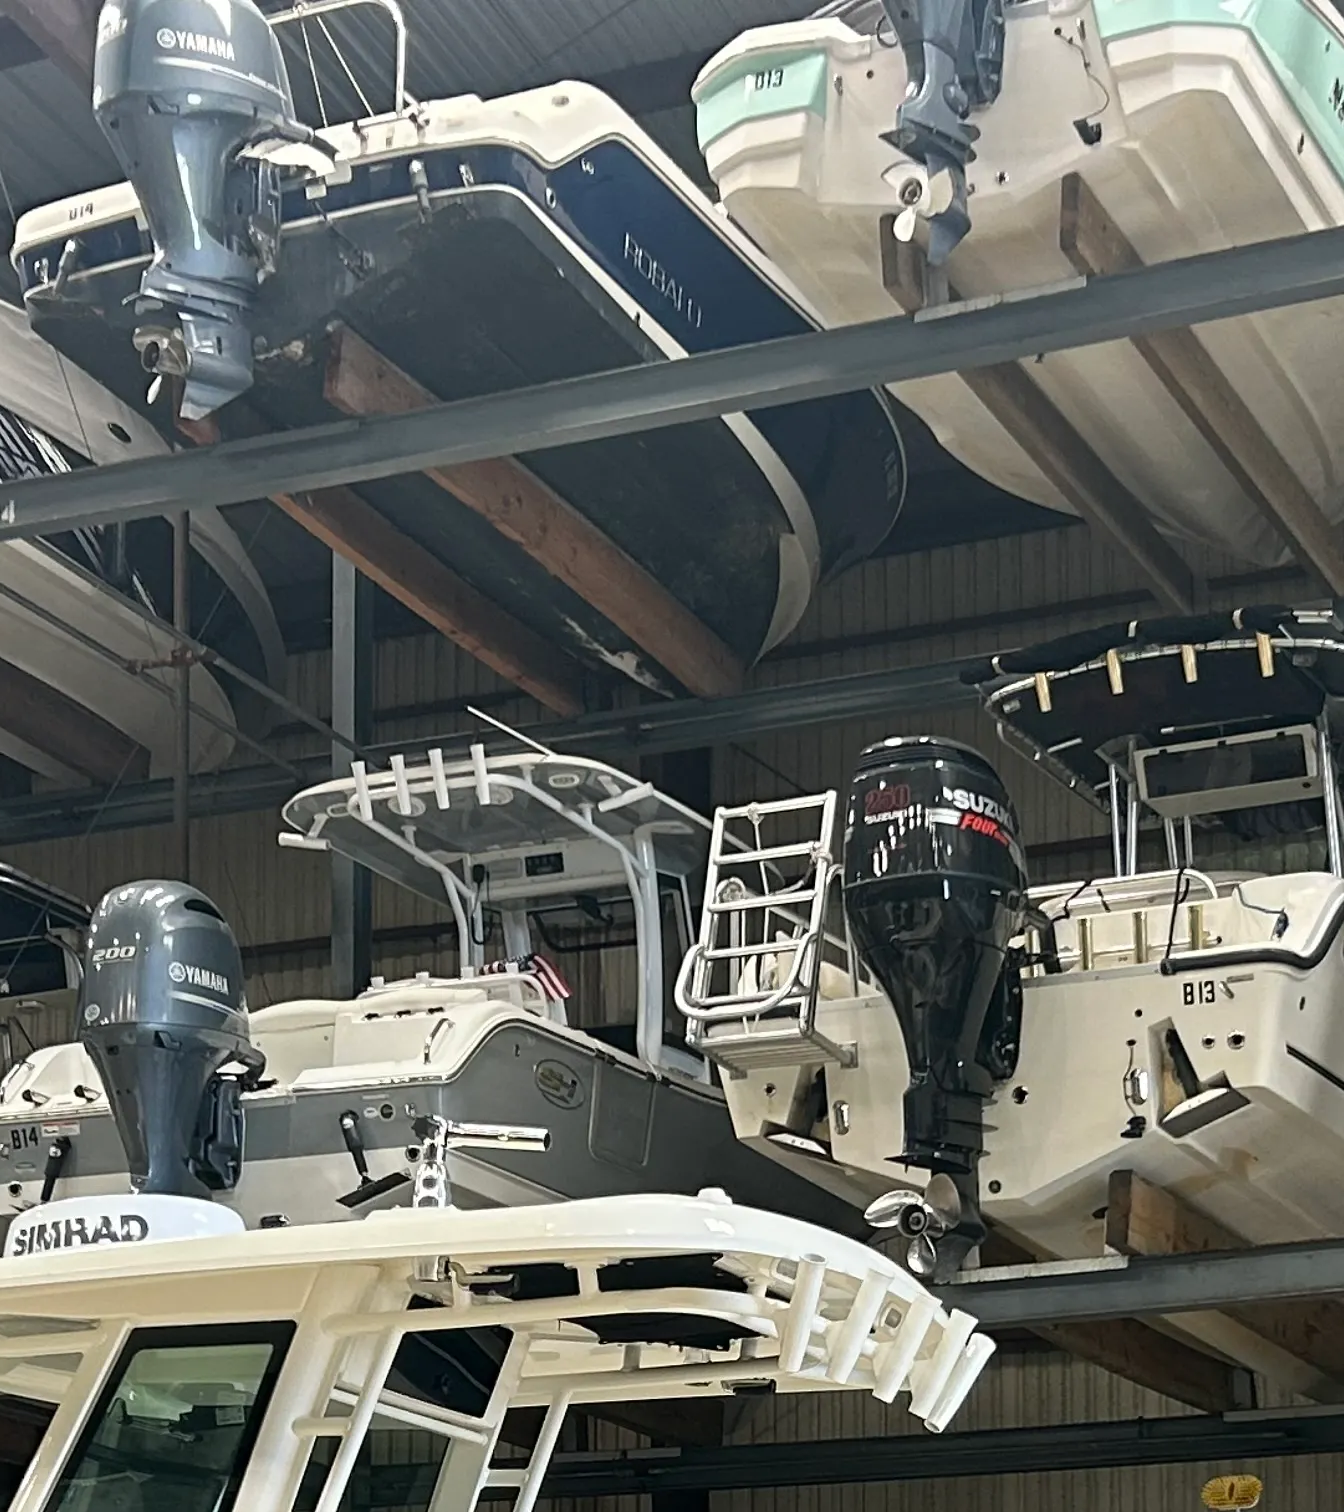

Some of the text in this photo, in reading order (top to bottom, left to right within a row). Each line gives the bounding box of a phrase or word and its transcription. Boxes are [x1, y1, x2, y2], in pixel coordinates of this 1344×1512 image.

[176, 30, 236, 61] YAMAHA
[755, 69, 784, 91] D13
[92, 946, 135, 961] 200
[186, 966, 229, 995] YAMAHA
[11, 1127, 39, 1150] B14
[13, 1214, 149, 1257] SIMRAD
